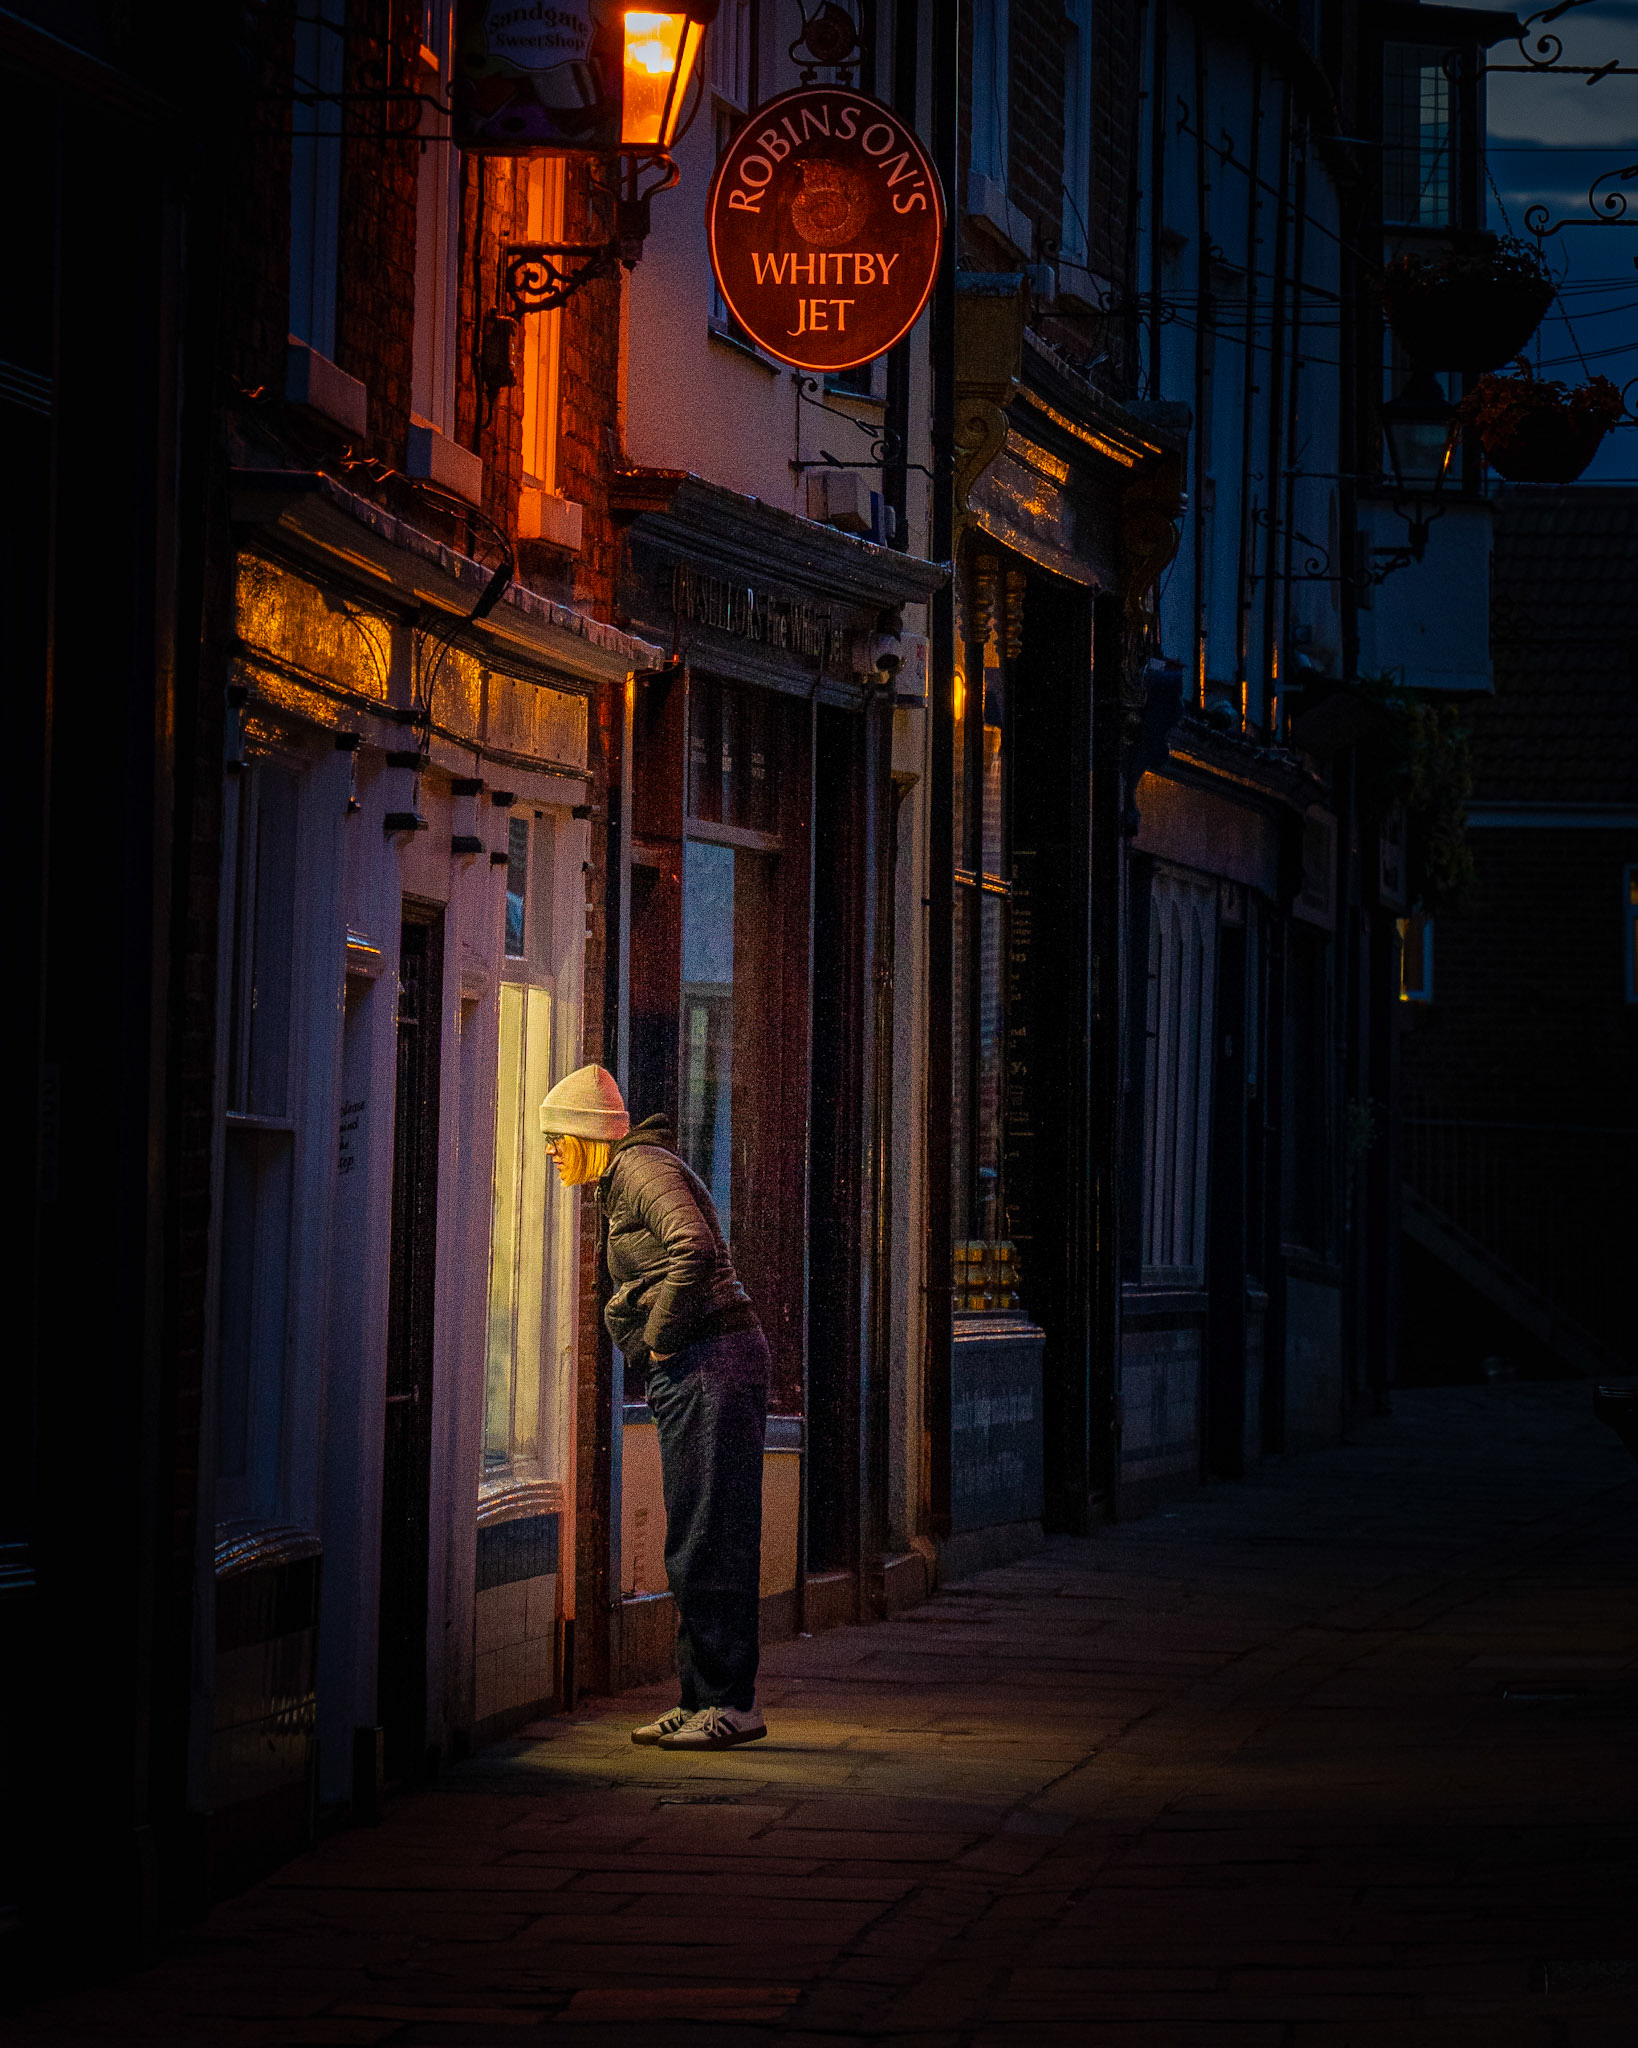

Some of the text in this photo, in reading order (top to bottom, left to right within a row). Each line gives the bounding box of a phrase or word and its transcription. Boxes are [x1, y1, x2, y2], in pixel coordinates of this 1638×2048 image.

[489, 2, 588, 36] Sandgate
[496, 33, 585, 51] Sweet Shop
[728, 104, 927, 214] ROBINSON'S
[751, 252, 899, 285] WHITBY
[787, 299, 855, 336] JET
[696, 572, 761, 641] SELLORS
